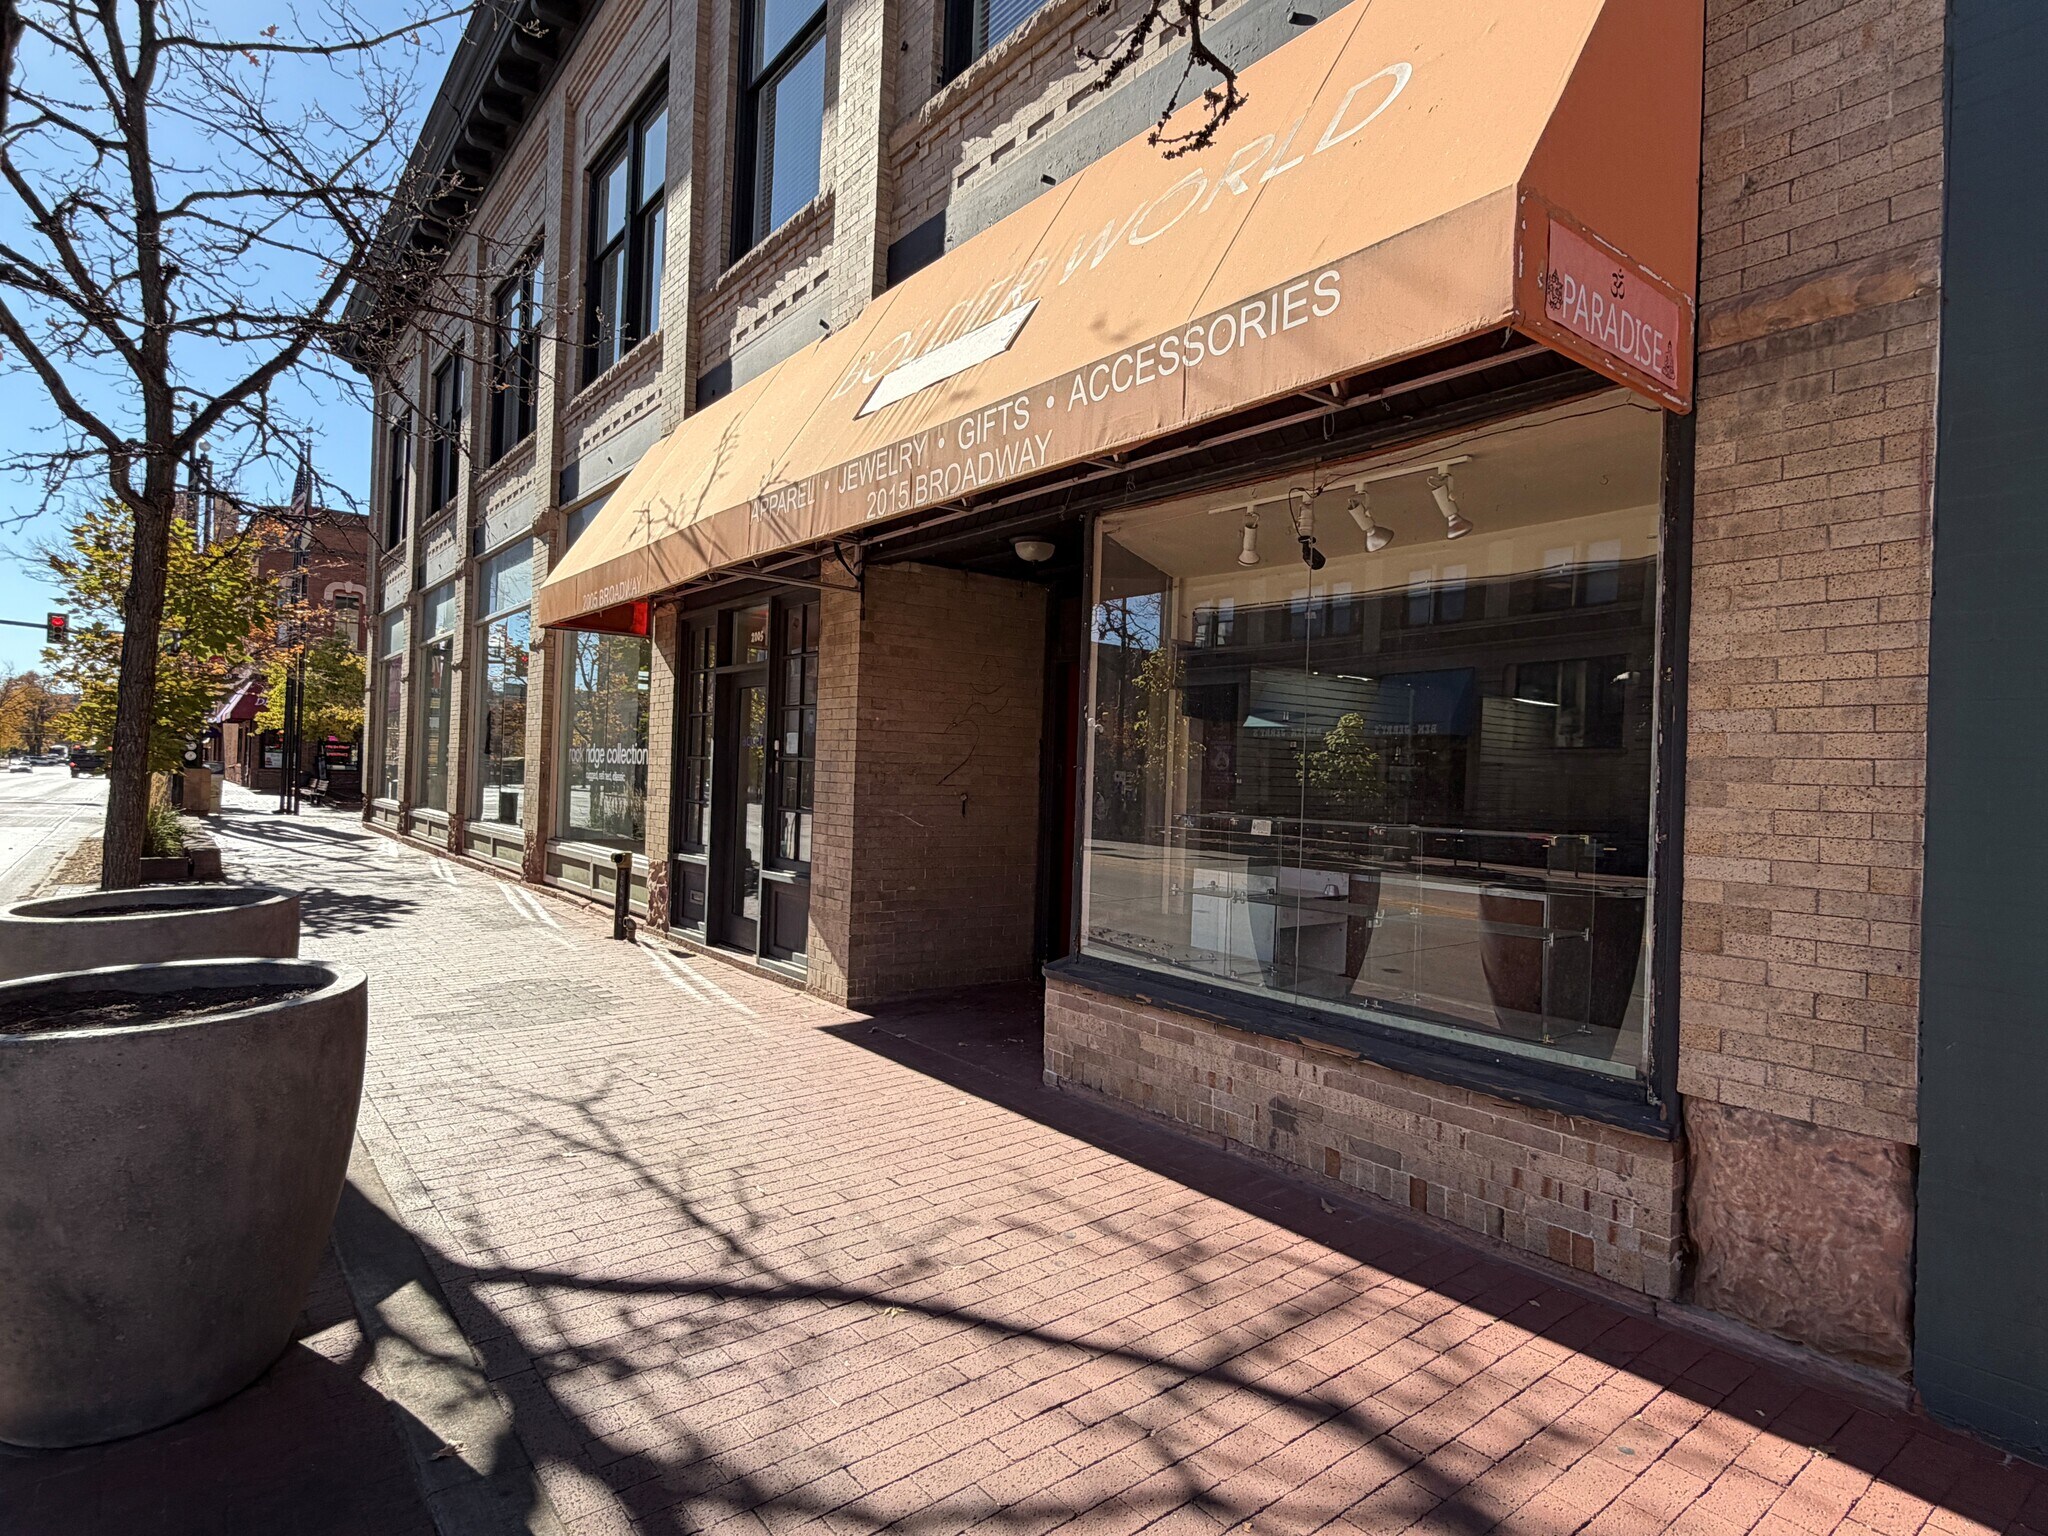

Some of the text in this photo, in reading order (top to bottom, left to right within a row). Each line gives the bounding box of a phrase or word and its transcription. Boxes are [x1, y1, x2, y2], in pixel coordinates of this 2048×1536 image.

[1058, 62, 1413, 285] WORLD
[1562, 273, 1663, 373] PARADISE
[750, 269, 1341, 524] APPAREL JEWELRY GIFTS ACCESSORIES
[866, 429, 1053, 520] 2015 BROADWAY
[598, 574, 642, 606] BROADWAY
[569, 743, 649, 769] rock ridge collection
